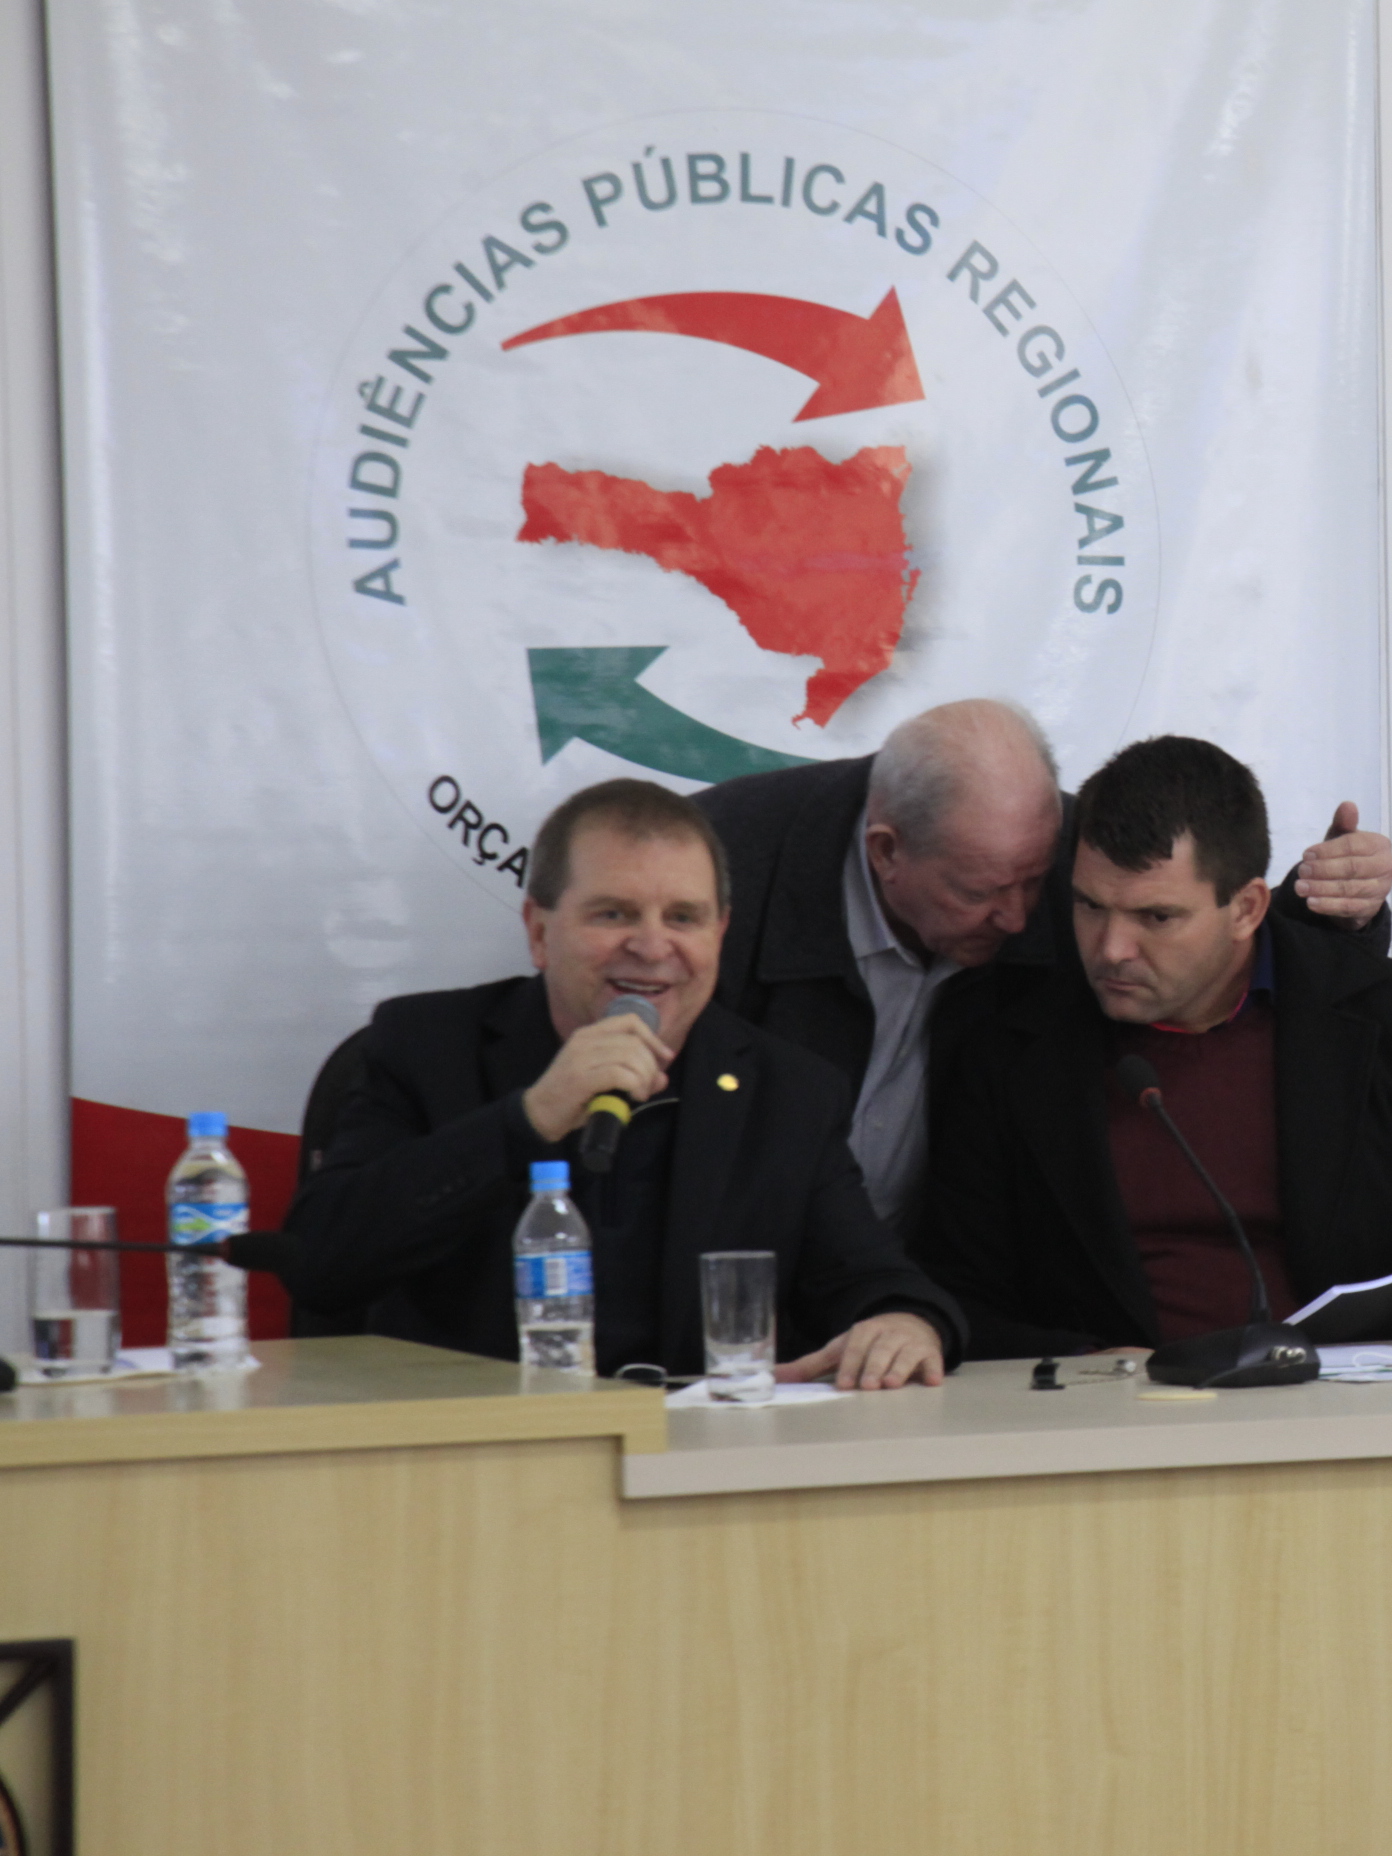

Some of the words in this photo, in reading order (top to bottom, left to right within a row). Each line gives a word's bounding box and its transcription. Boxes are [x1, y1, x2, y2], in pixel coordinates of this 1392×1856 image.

[347, 200, 570, 607] AUDIÊNCIAS
[580, 144, 941, 257] PÚBLICAS
[945, 240, 1126, 615] REGIONAIS
